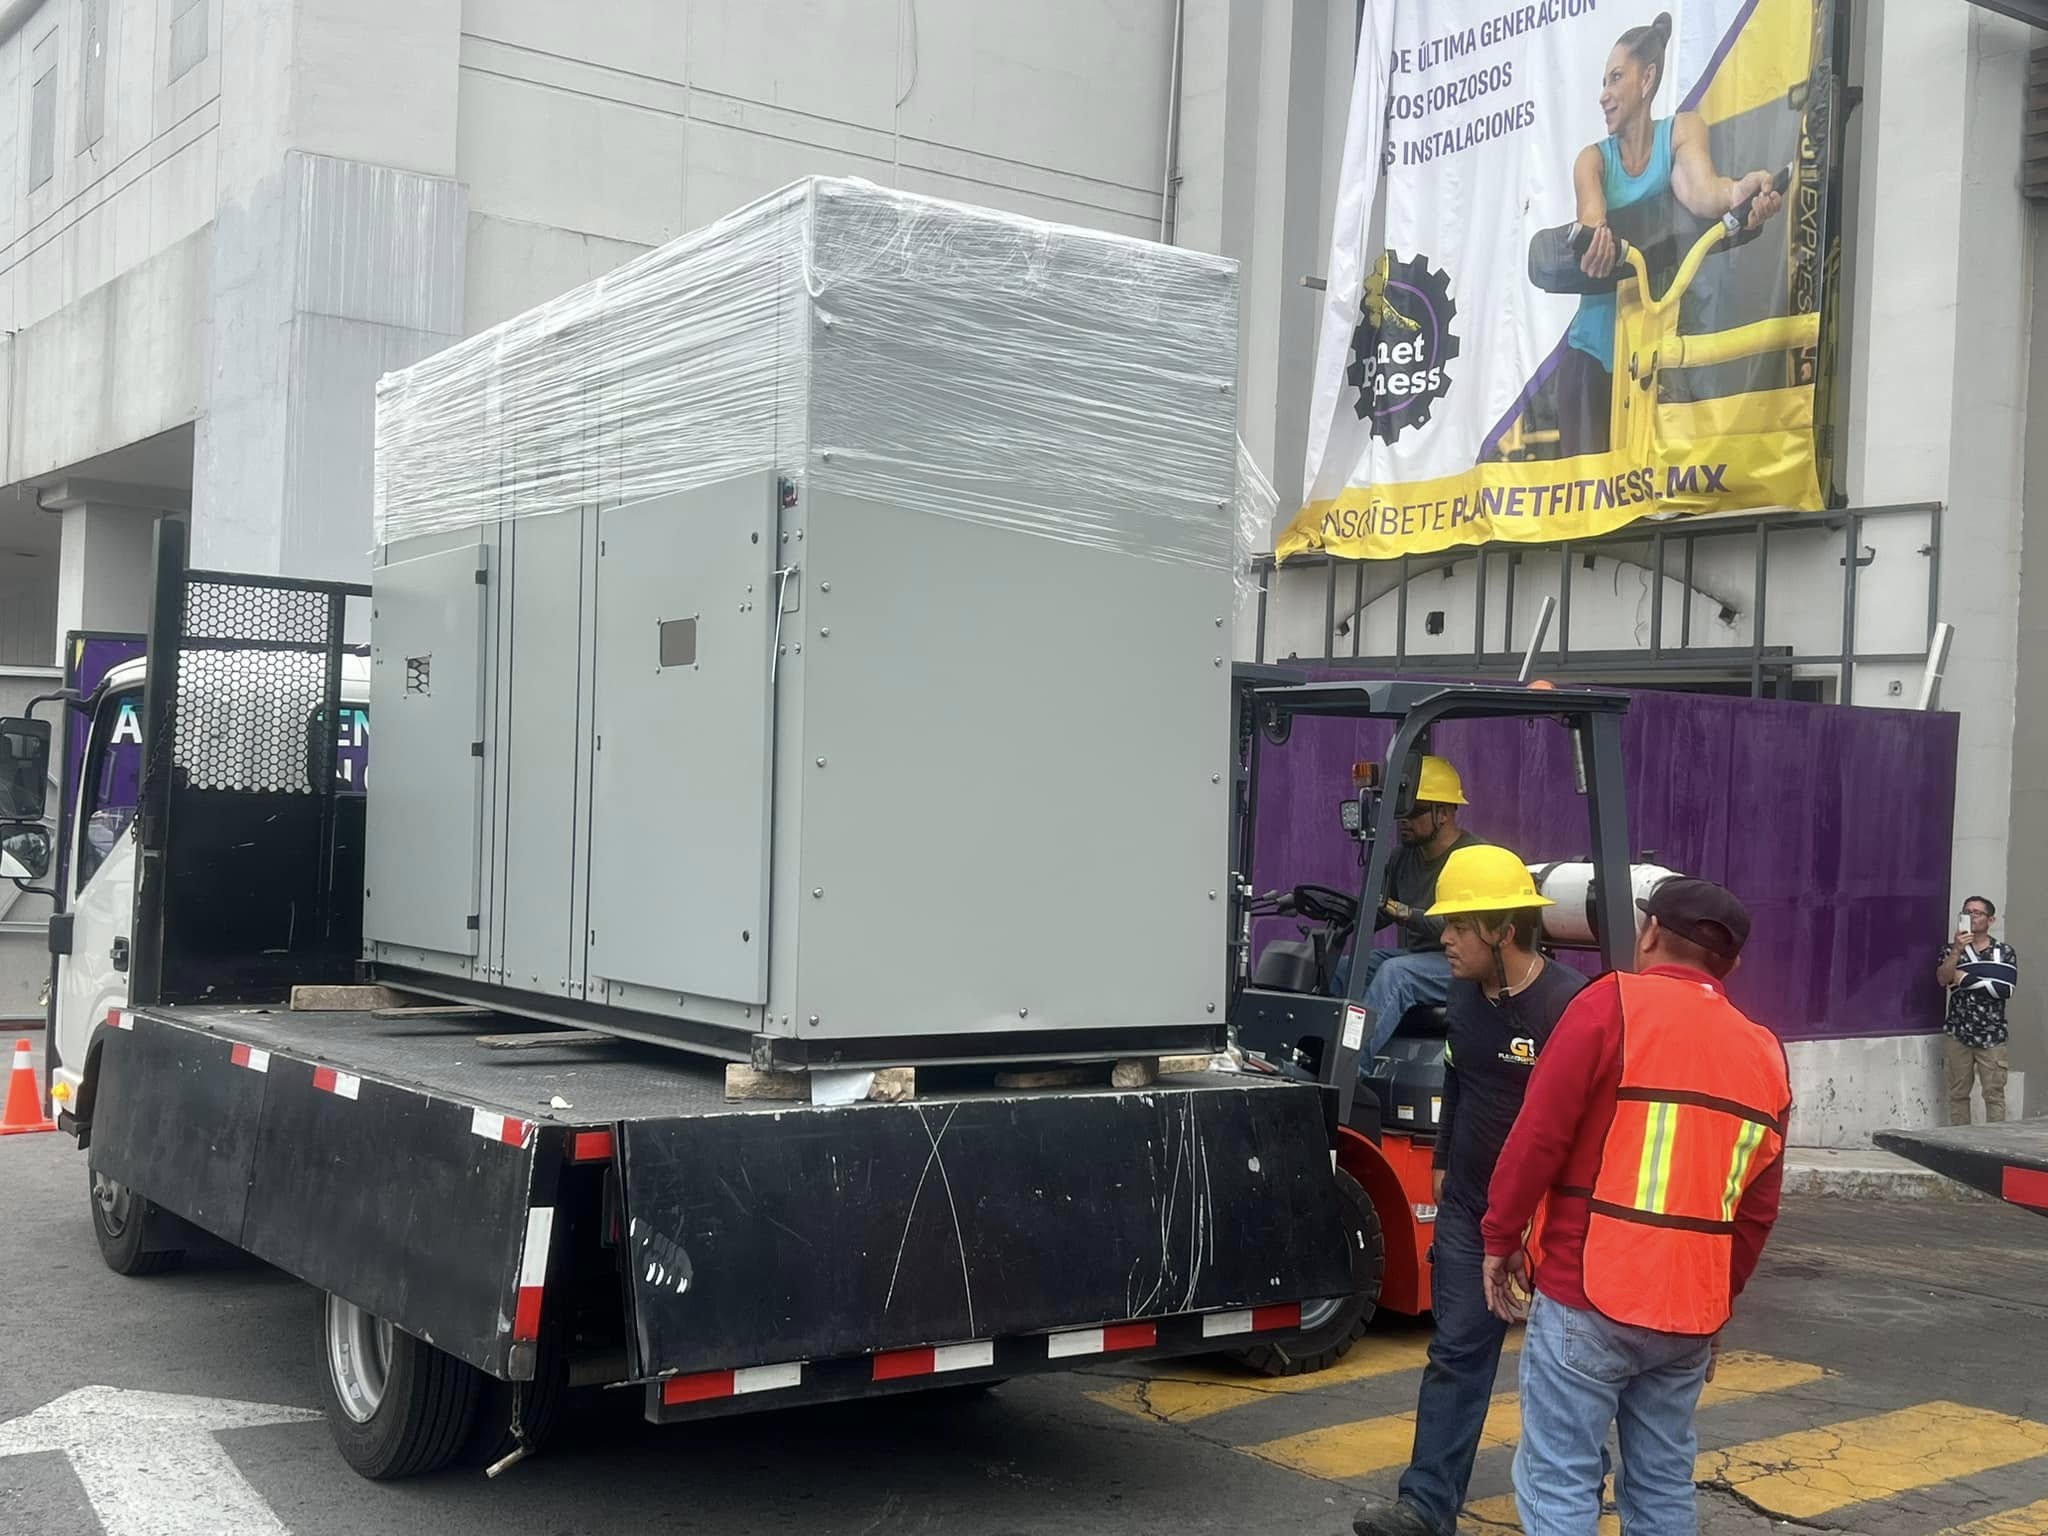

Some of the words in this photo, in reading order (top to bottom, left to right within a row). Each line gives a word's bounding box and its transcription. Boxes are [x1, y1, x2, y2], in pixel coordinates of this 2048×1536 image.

[1418, 28, 1477, 72] ÚLTIMA
[1427, 61, 1513, 115] FORZOSOS
[1403, 100, 1536, 166] INSTALACIONES
